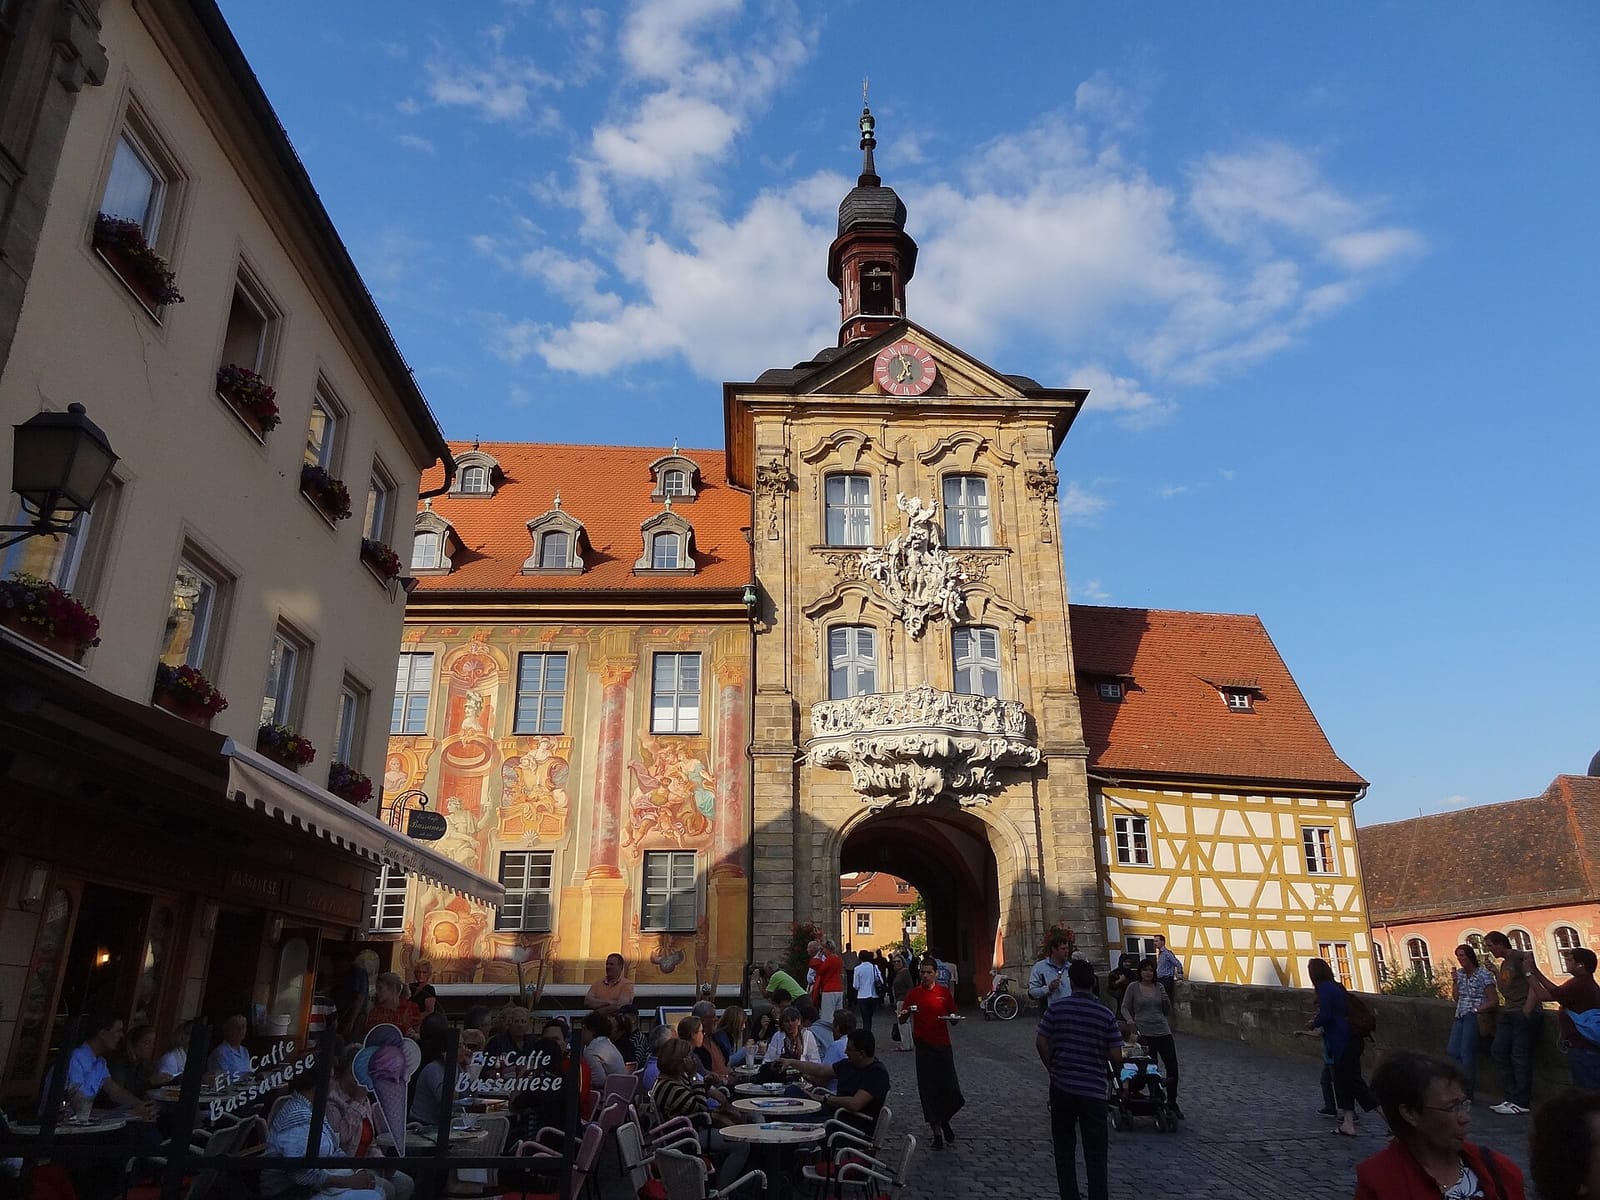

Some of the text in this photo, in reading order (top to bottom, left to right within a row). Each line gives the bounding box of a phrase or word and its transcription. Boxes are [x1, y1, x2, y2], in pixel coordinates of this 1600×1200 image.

[214, 1040, 295, 1092] Eis Caffe
[470, 1049, 551, 1070] Eis Caffe
[209, 1053, 316, 1121] Bassanese
[454, 1070, 563, 1093] Bassanese
